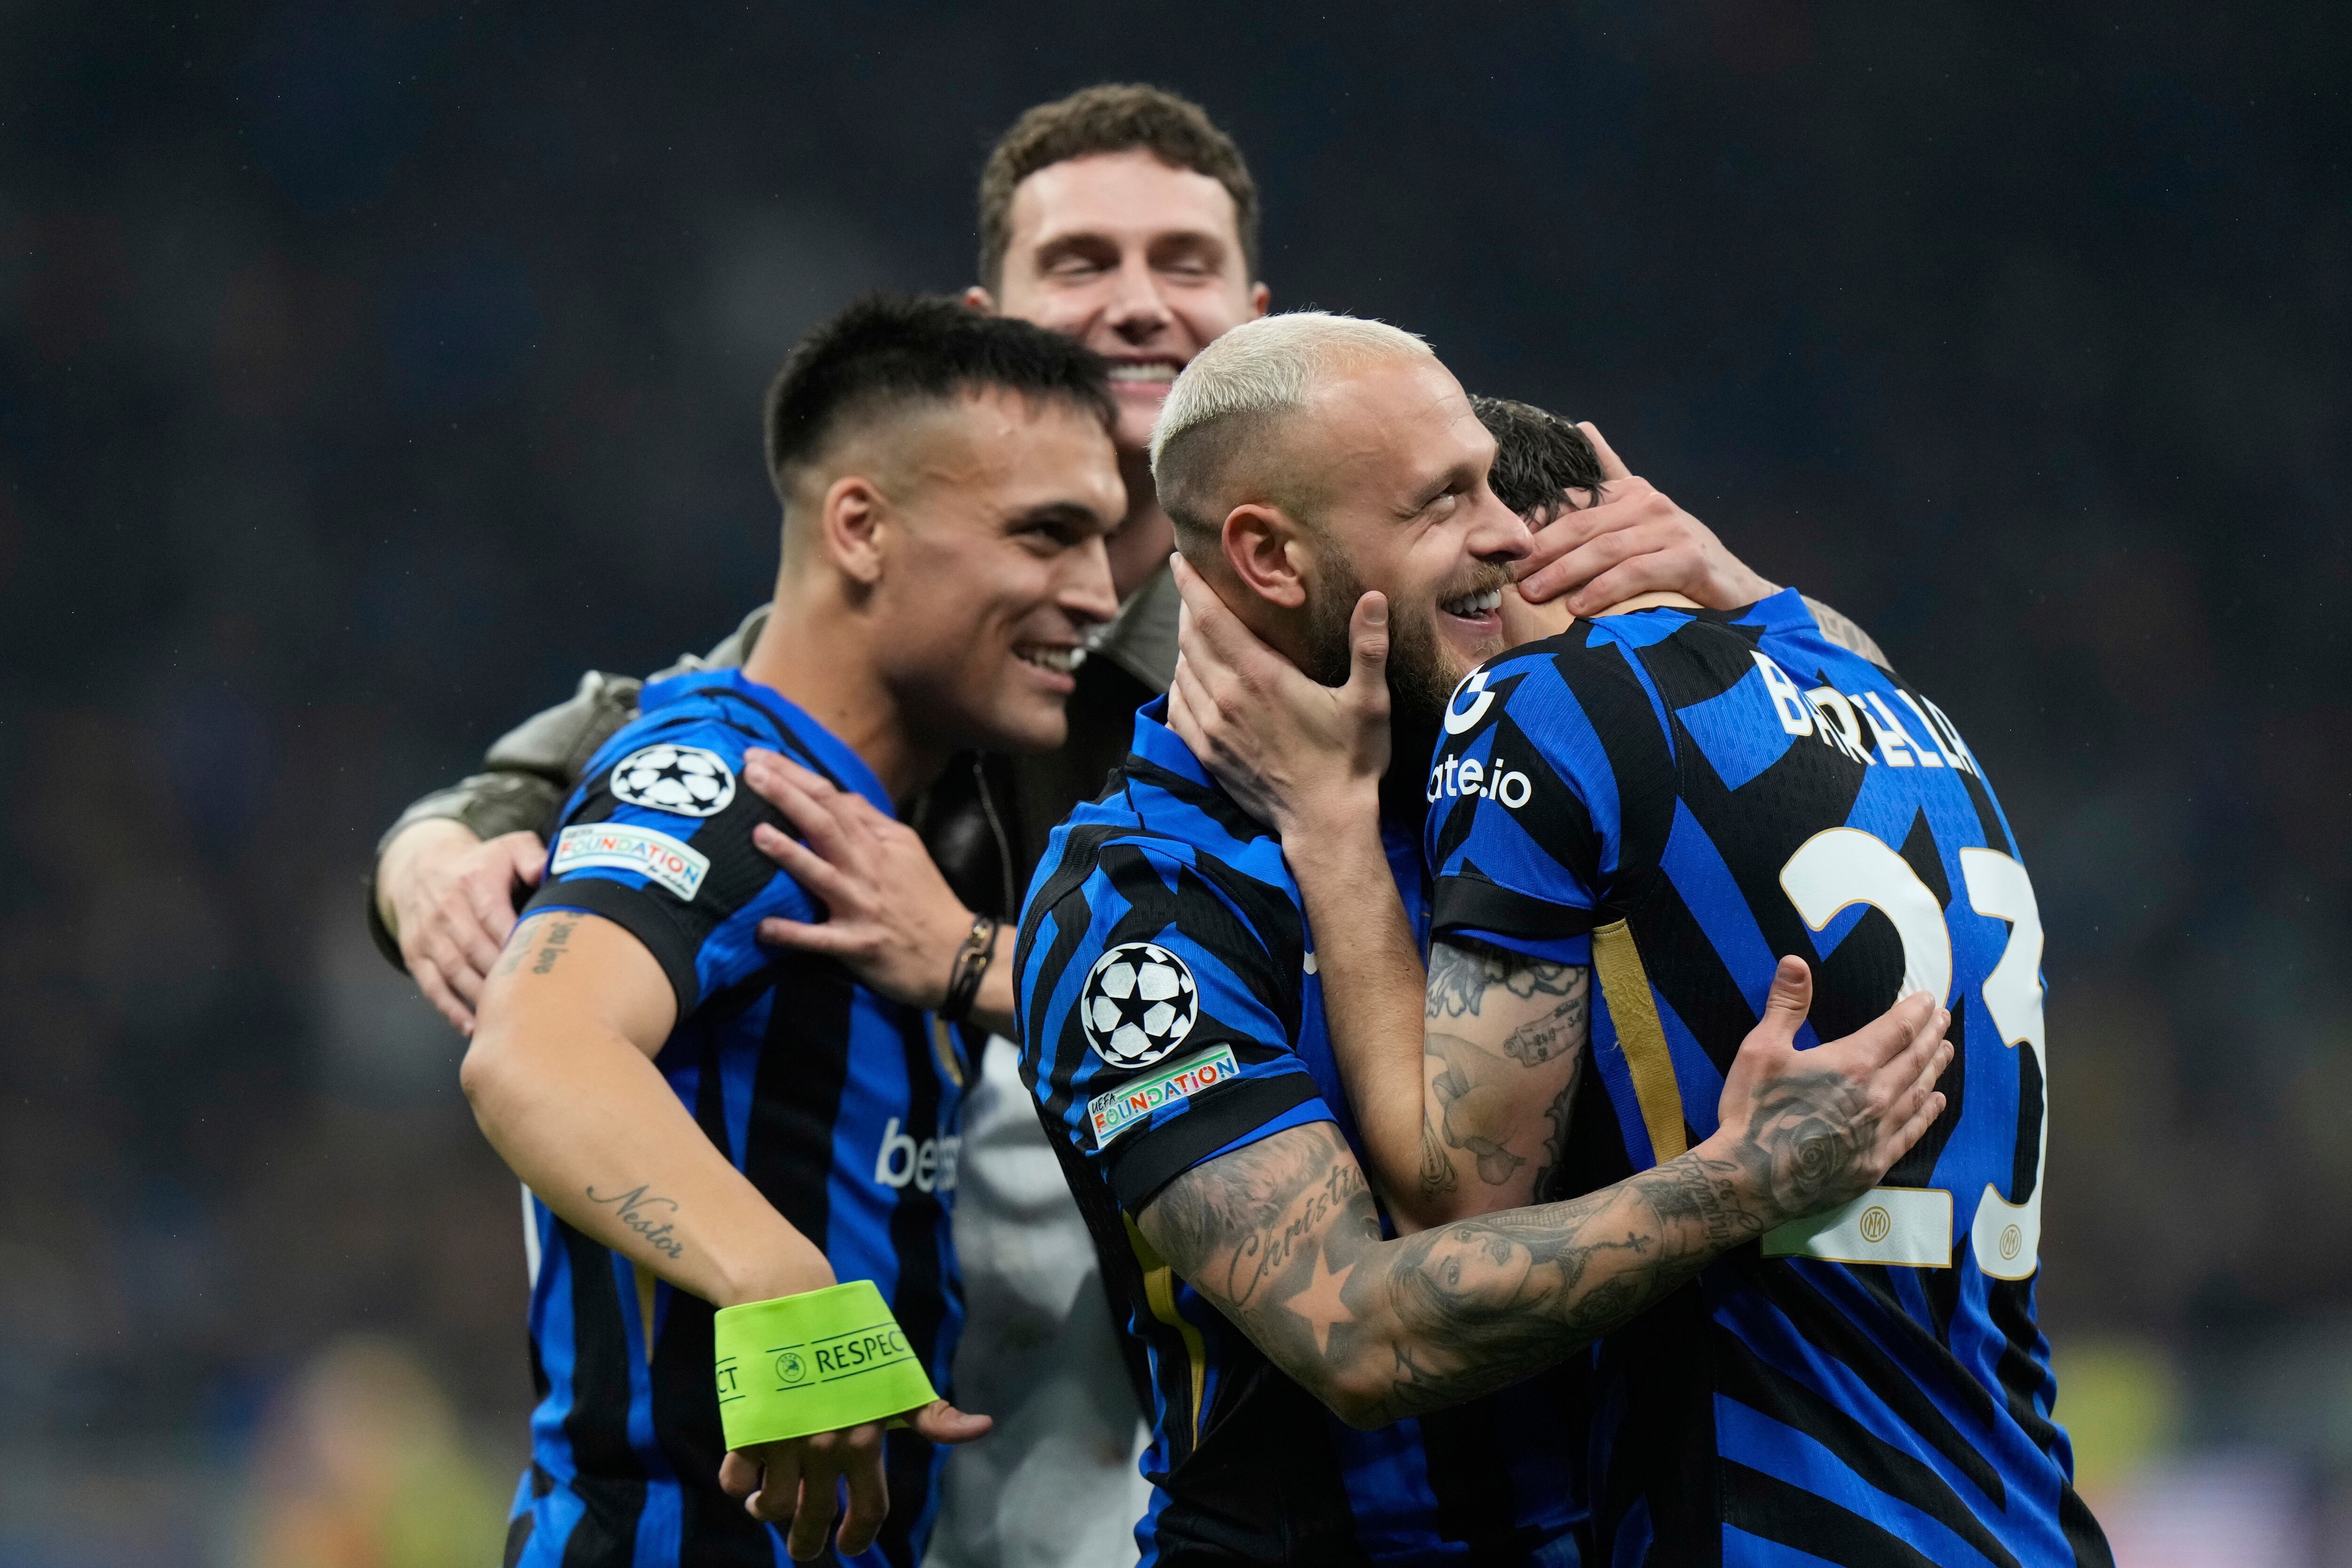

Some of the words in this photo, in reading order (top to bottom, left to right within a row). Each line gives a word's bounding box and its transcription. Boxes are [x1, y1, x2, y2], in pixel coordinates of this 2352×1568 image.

[1749, 650, 1981, 780] BARELLA
[560, 836, 700, 885] FOUNDATION
[1759, 826, 2048, 1280] 23
[1091, 1093, 1116, 1114] UEFA
[1094, 1057, 1237, 1133] FOUNDATION
[587, 1184, 683, 1259] Nestor
